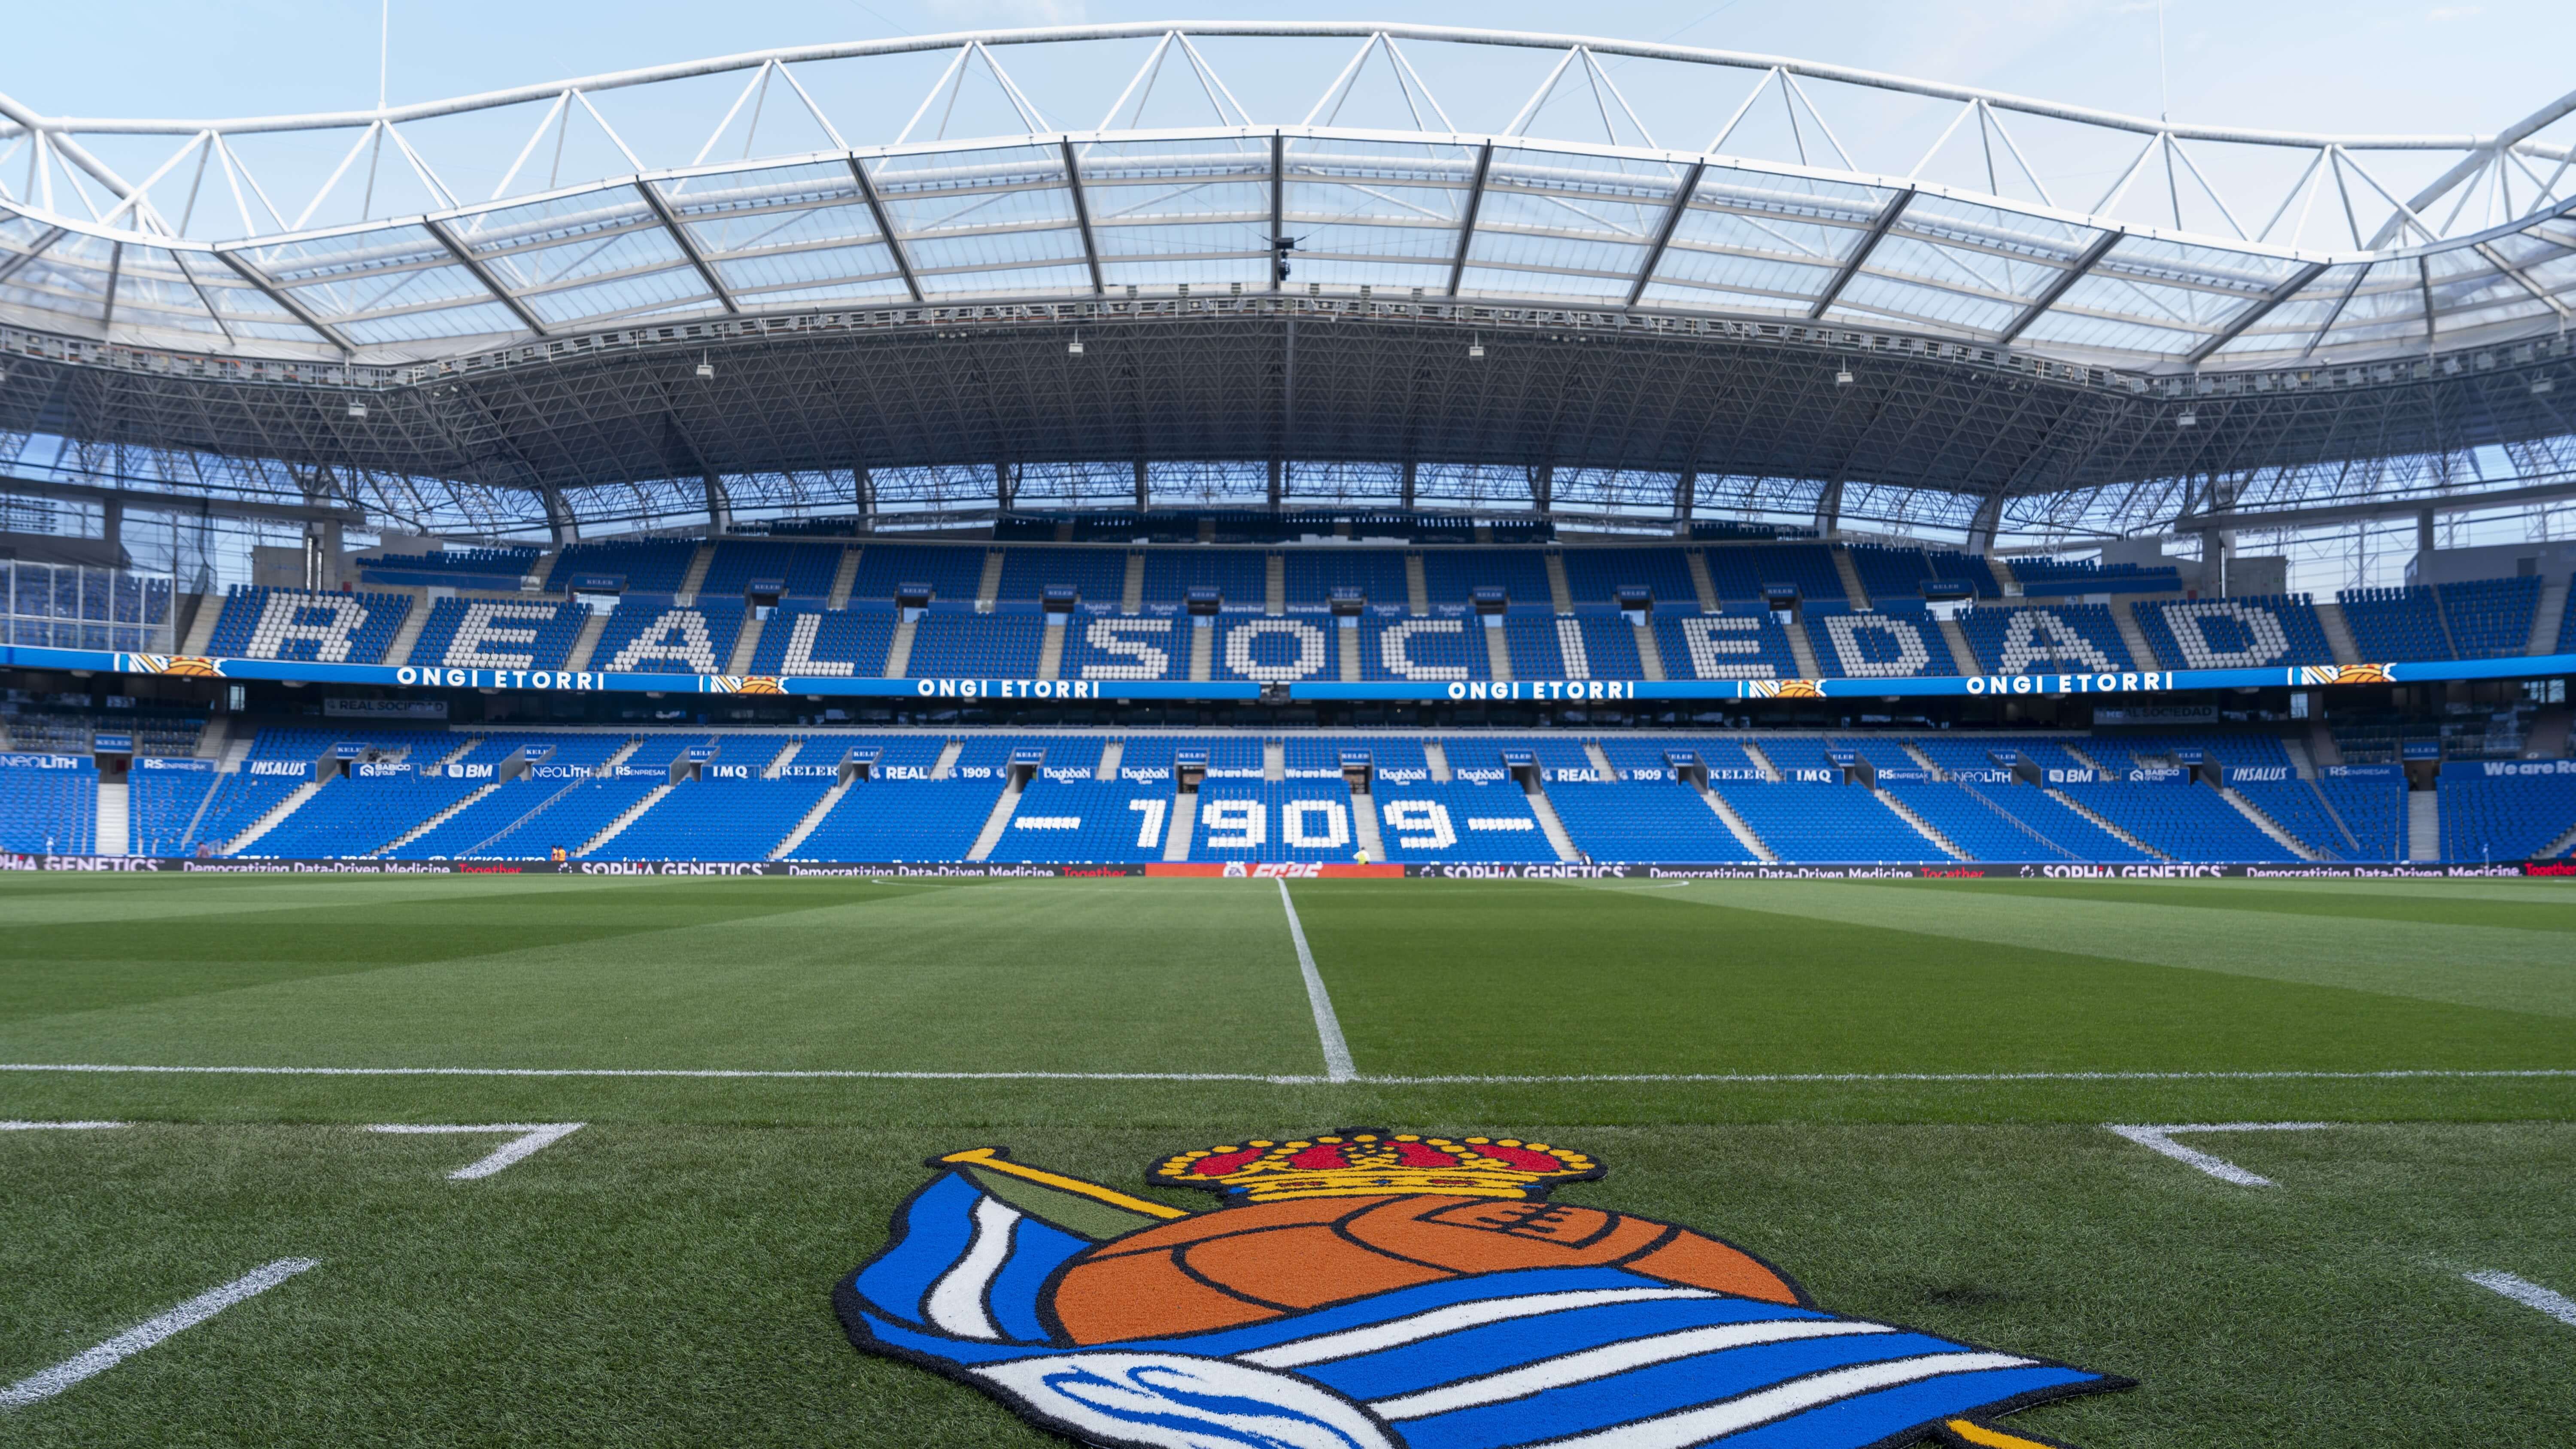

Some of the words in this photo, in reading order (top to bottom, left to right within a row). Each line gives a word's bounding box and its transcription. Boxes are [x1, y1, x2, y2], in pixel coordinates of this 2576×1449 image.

[246, 592, 854, 676] REAL
[1081, 602, 2289, 680] SOCIEDAD
[397, 666, 477, 687] ONGI
[495, 670, 604, 690] ETORRI
[1966, 676, 2042, 694] ONGI
[2059, 672, 2173, 692] ETORRI
[917, 679, 987, 697] ONGI
[1002, 680, 1099, 698] ETORRI
[1448, 681, 1519, 699] ONGI
[1533, 681, 1634, 699] ETORRI
[339, 701, 374, 711] REAL
[250, 762, 307, 775] INSALUS
[465, 764, 492, 778] BM
[713, 766, 748, 778] IMQ
[782, 766, 838, 776] KELER
[886, 767, 928, 779] REAL
[962, 767, 991, 778] 1909
[1206, 769, 1223, 778] We
[1242, 769, 1264, 778] Real
[1285, 769, 1301, 778] We
[1320, 769, 1342, 778] Real
[2233, 767, 2287, 781] INSALUS
[2483, 762, 2515, 776] We
[2518, 763, 2552, 774] are
[1558, 769, 1599, 782] REAL
[1633, 770, 1662, 780] 1909
[1710, 770, 1766, 780] KELER
[1797, 770, 1832, 783] IMQ
[2066, 769, 2093, 783] BM
[294, 862, 380, 873] Data-Driven
[385, 862, 450, 873] Medicine
[899, 866, 984, 876] Data-Driven
[989, 866, 1054, 877] Medicine
[1759, 867, 1844, 878] Data-Driven
[1849, 867, 1914, 878] Medicine
